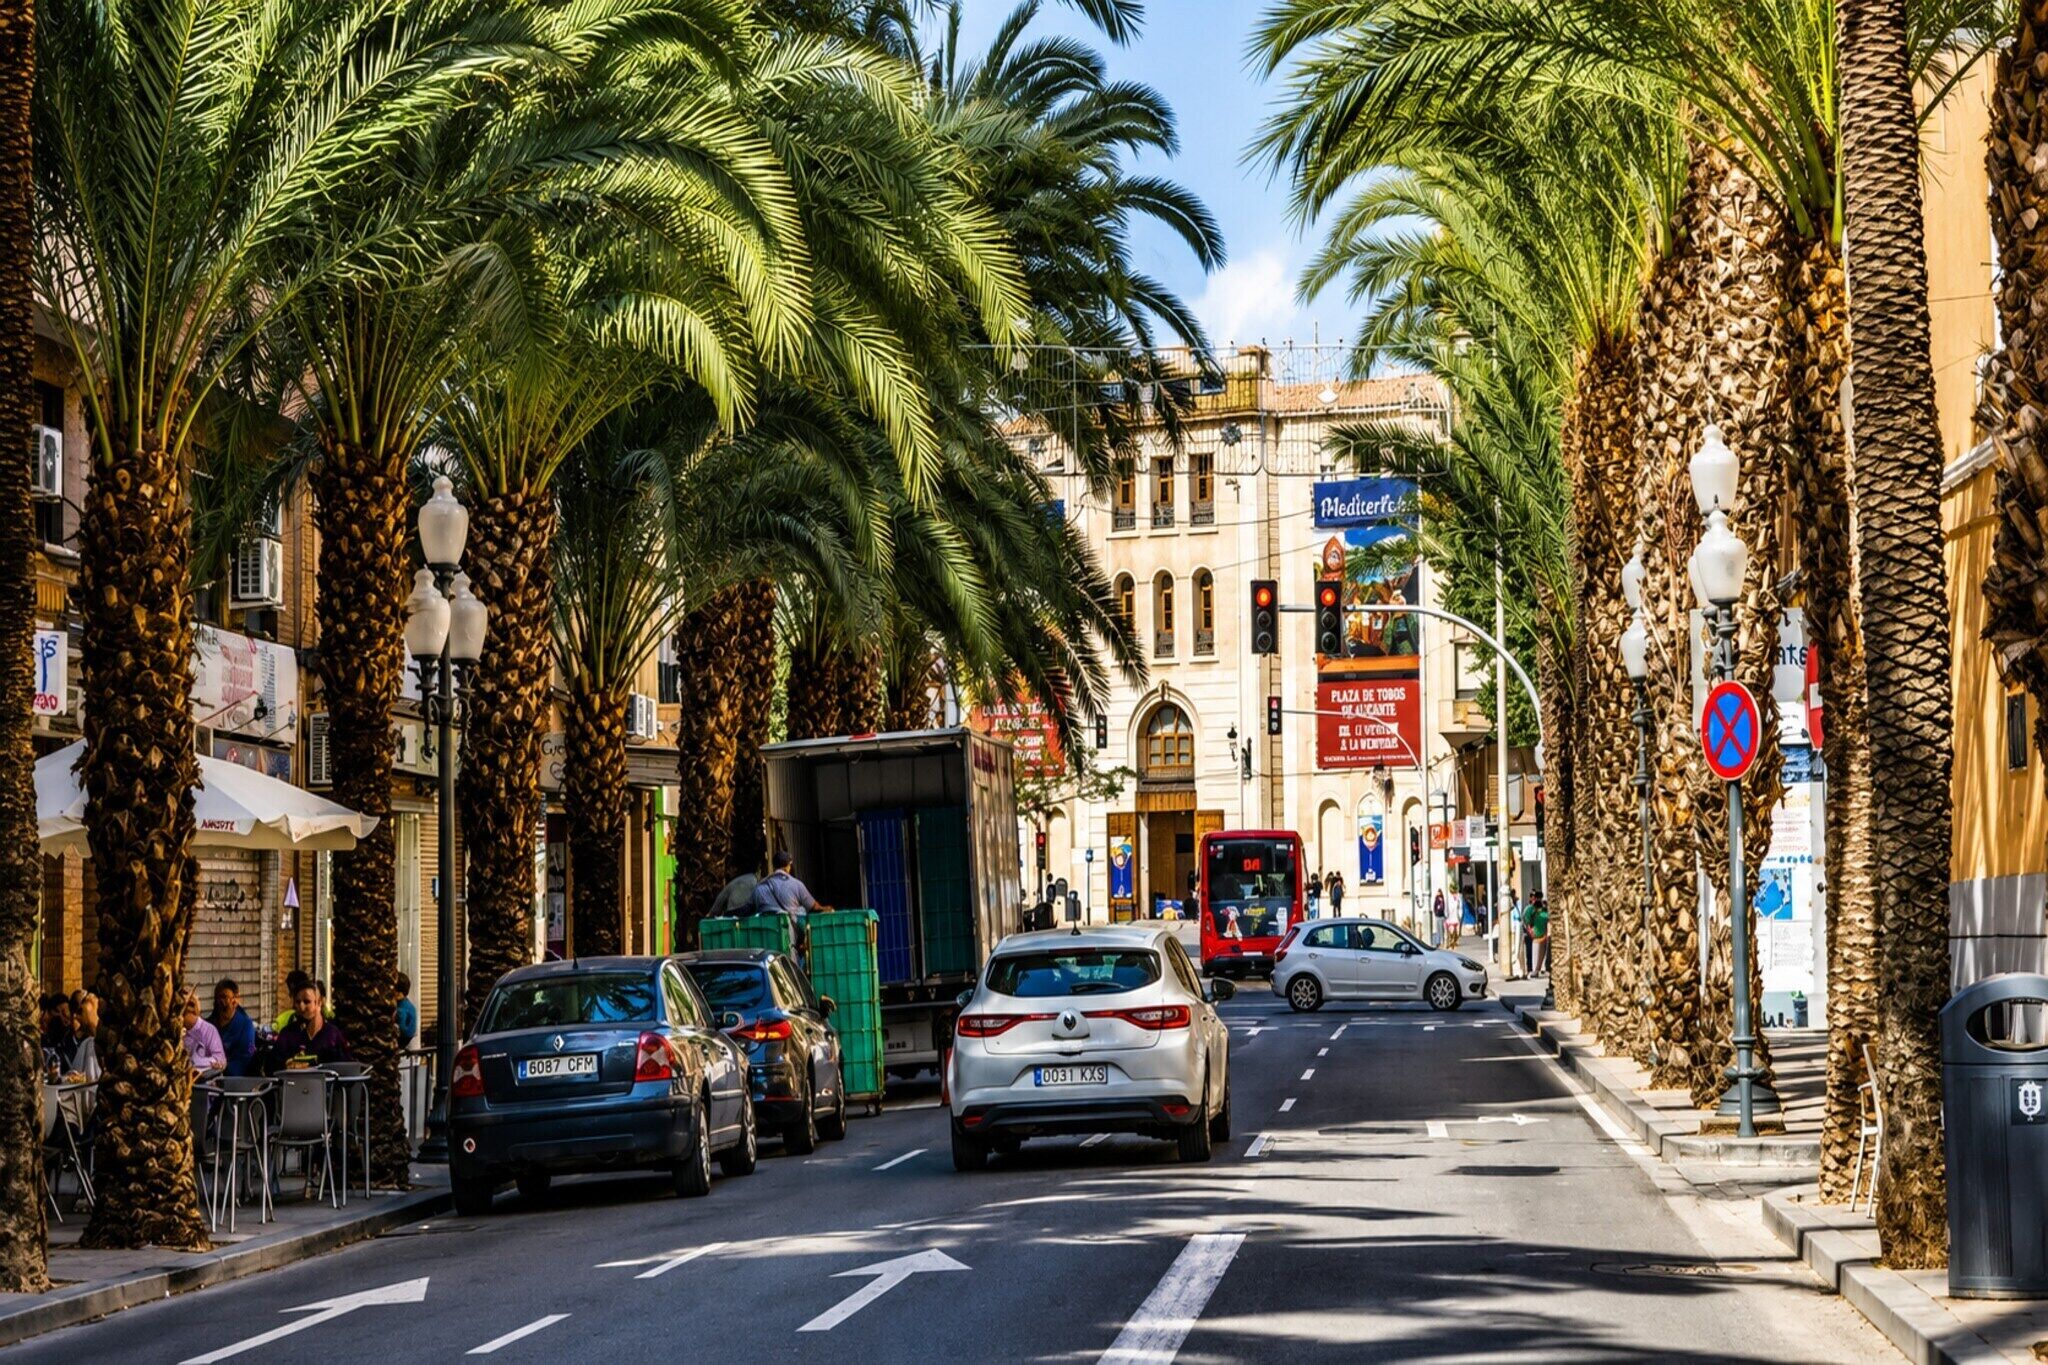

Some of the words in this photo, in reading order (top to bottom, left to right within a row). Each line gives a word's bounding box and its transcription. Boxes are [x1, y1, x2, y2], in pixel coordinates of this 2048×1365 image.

[1331, 688, 1360, 703] PLAZA
[1362, 688, 1375, 702] DE
[529, 1059, 561, 1075] 6087
[567, 1057, 595, 1072] CFM
[1043, 1068, 1074, 1083] 0031
[1080, 1066, 1105, 1082] KXS
